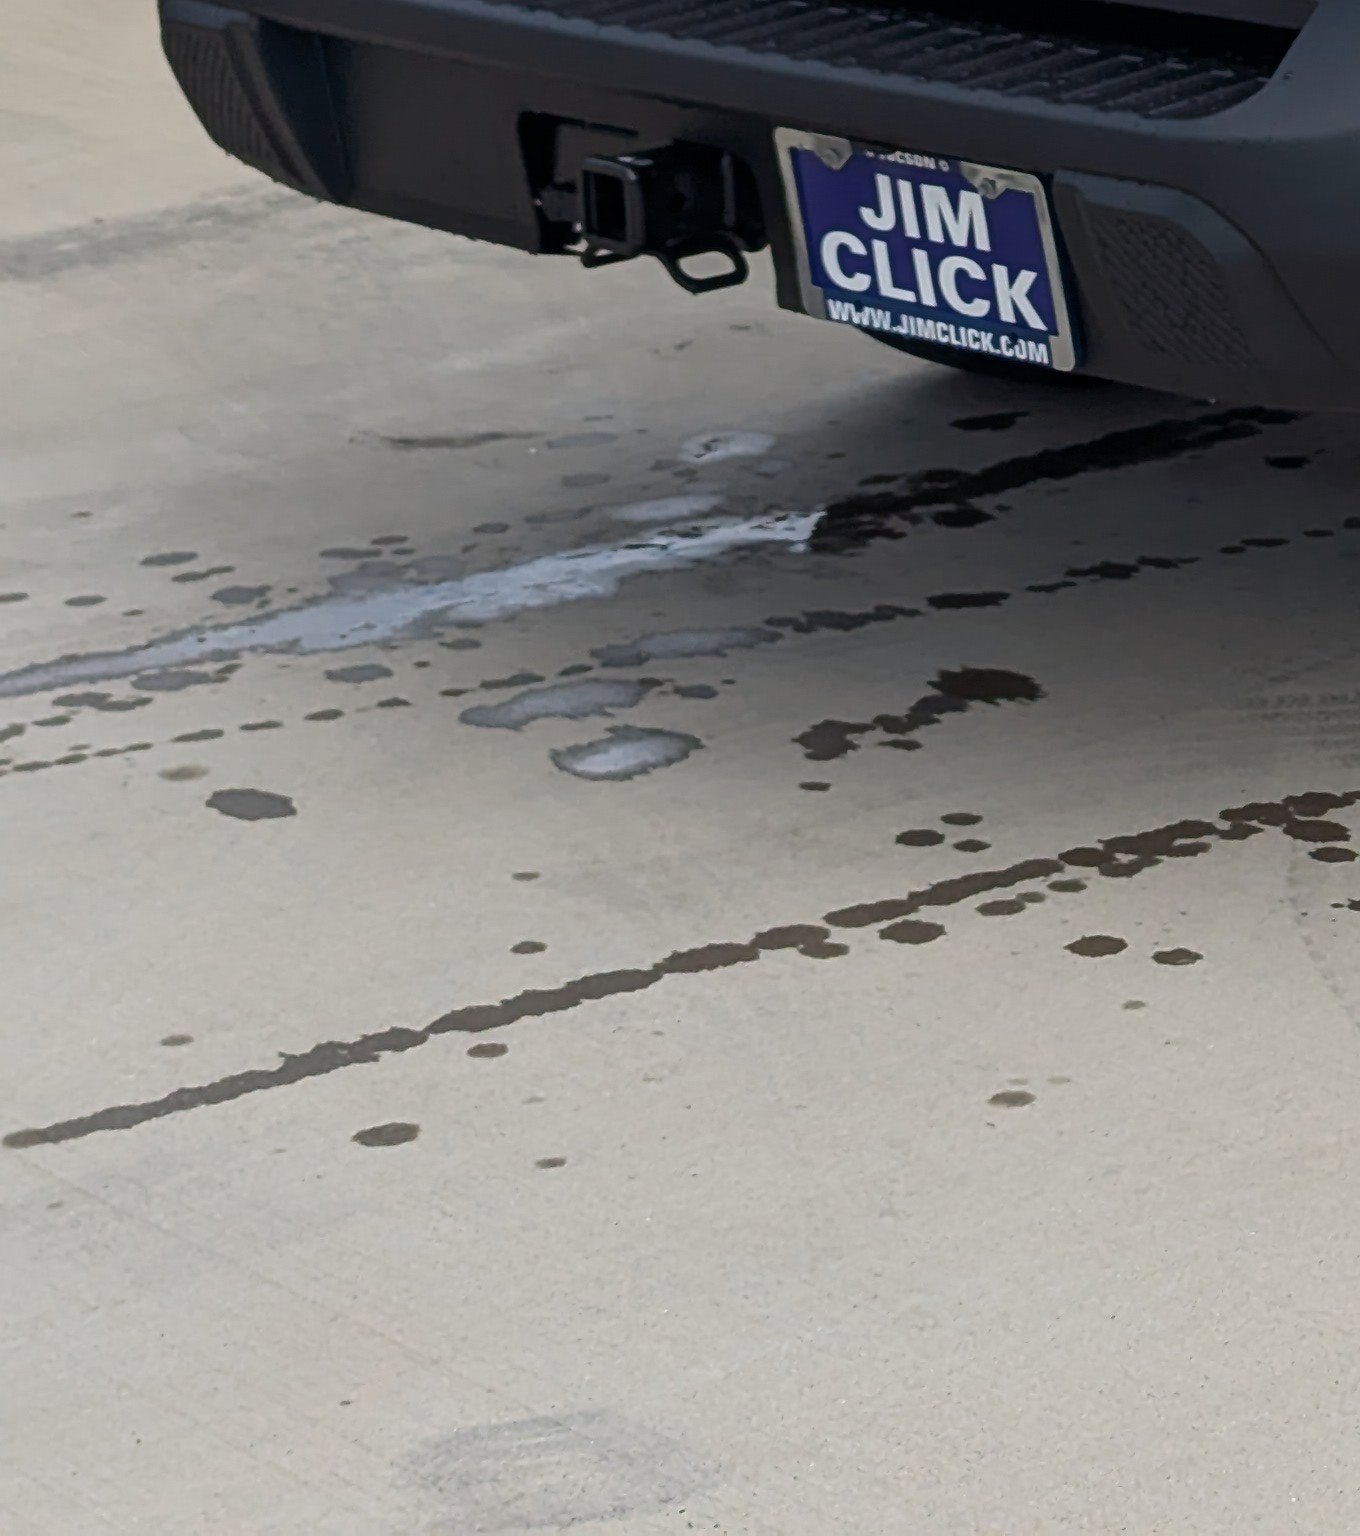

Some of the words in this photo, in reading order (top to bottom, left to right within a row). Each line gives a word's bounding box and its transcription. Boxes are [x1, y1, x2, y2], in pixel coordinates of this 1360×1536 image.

[859, 172, 992, 252] JIM
[820, 230, 1048, 331] CLICK
[827, 298, 1050, 364] WWW.JIMCLICK.COM
